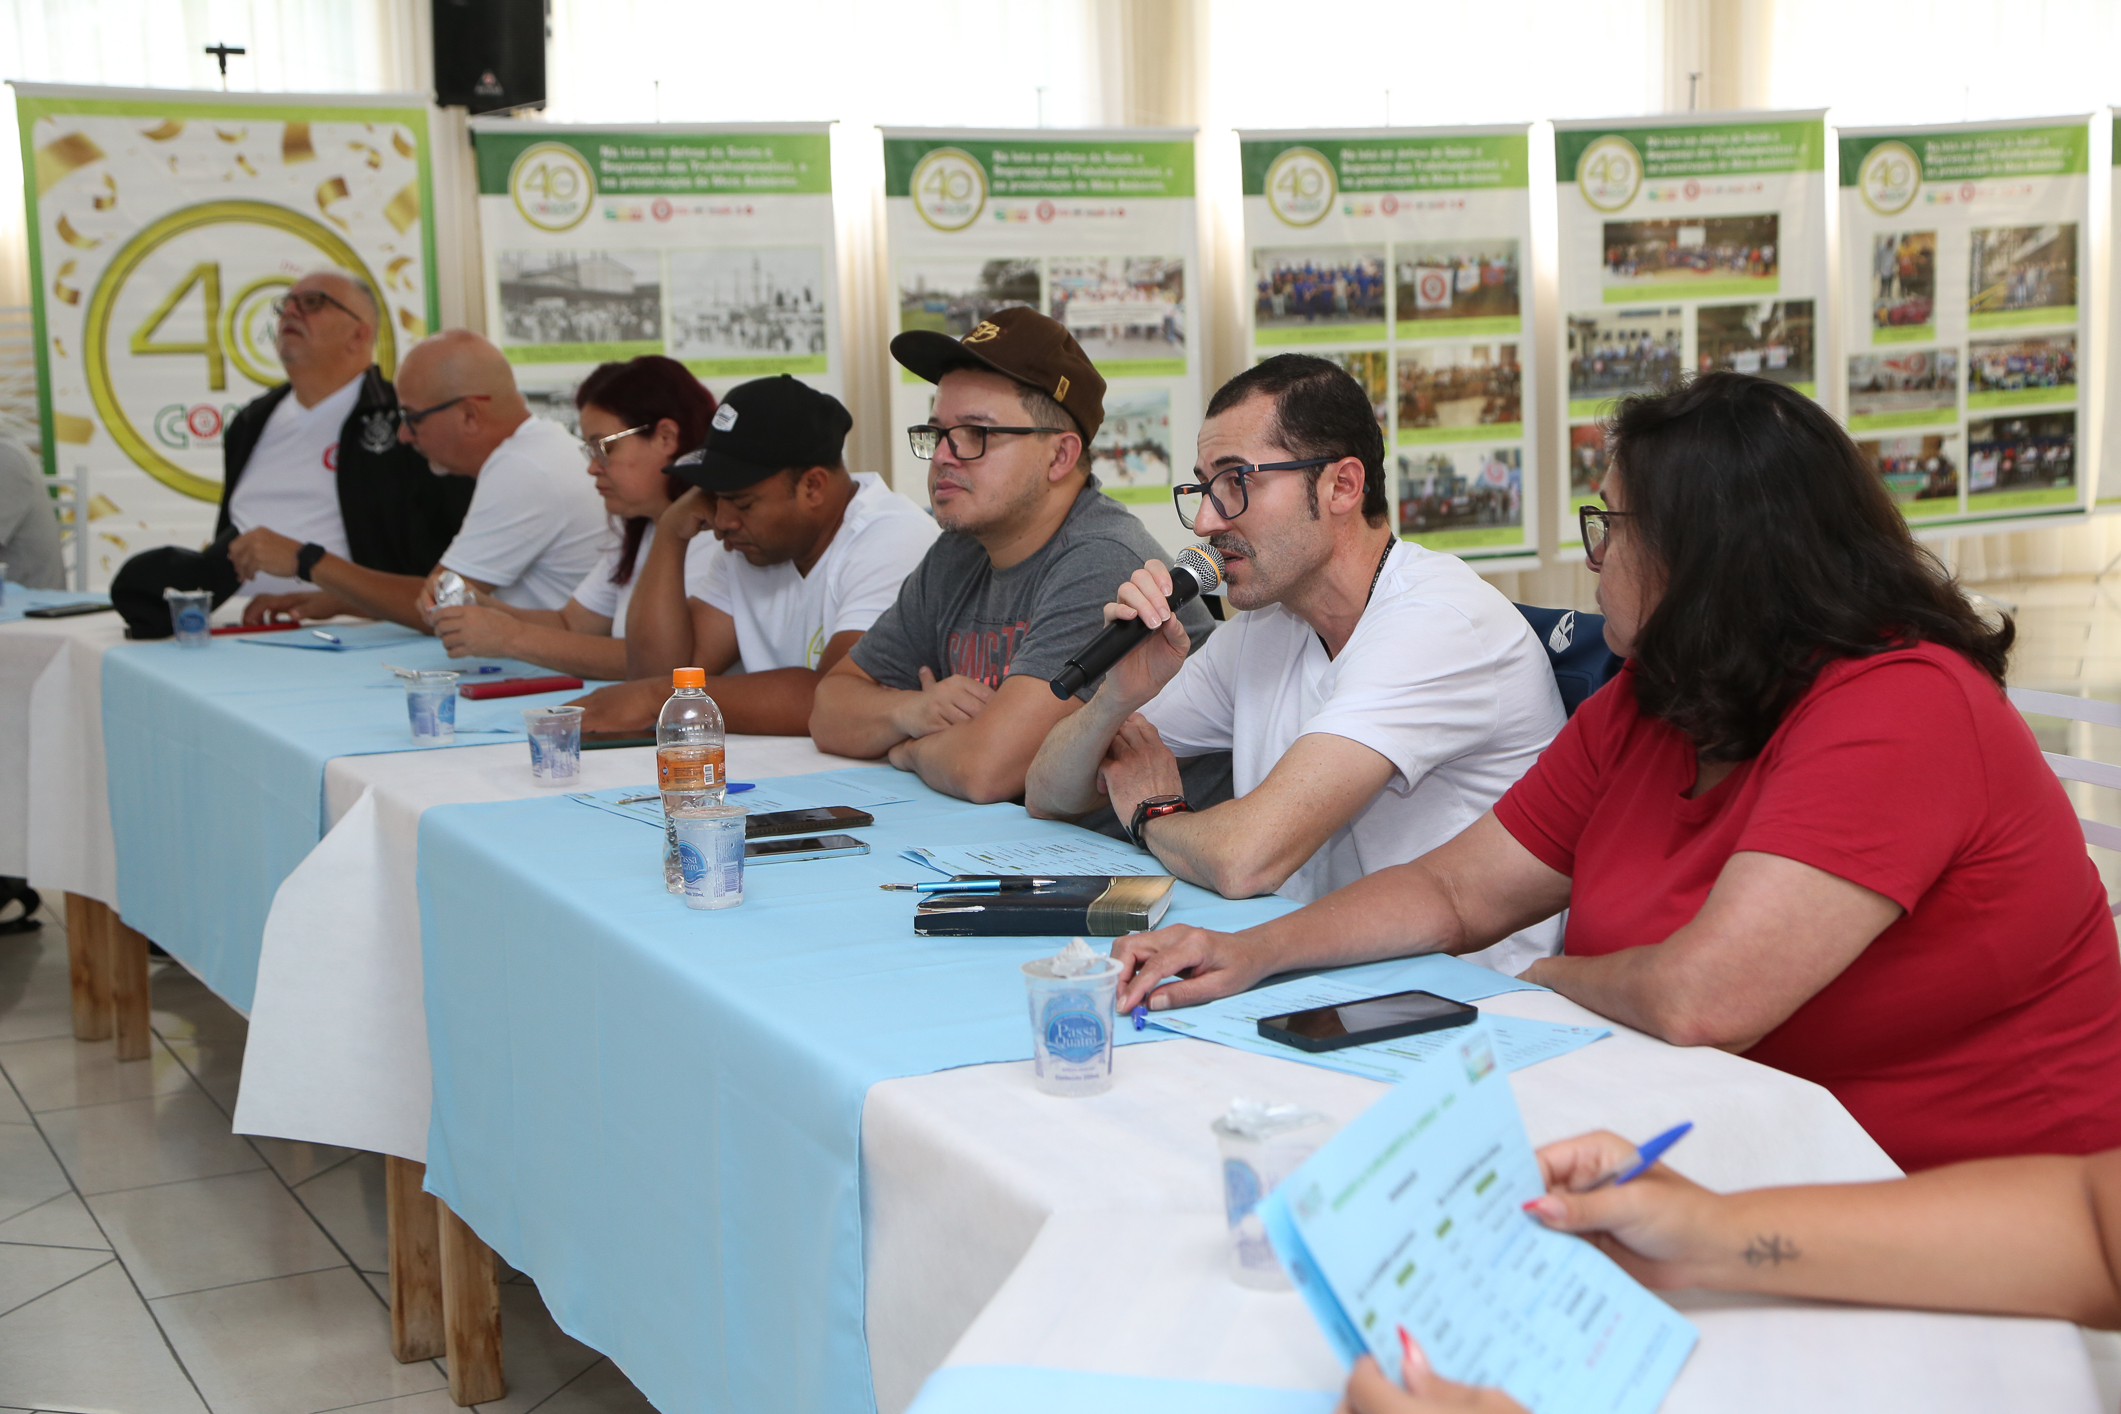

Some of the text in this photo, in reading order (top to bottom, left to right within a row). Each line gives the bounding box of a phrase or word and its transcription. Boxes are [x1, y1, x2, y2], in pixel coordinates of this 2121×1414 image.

[523, 163, 579, 200] 40
[923, 166, 974, 202] 40
[1055, 1036, 1098, 1049] Quatro
[1057, 1024, 1097, 1038] Passa
